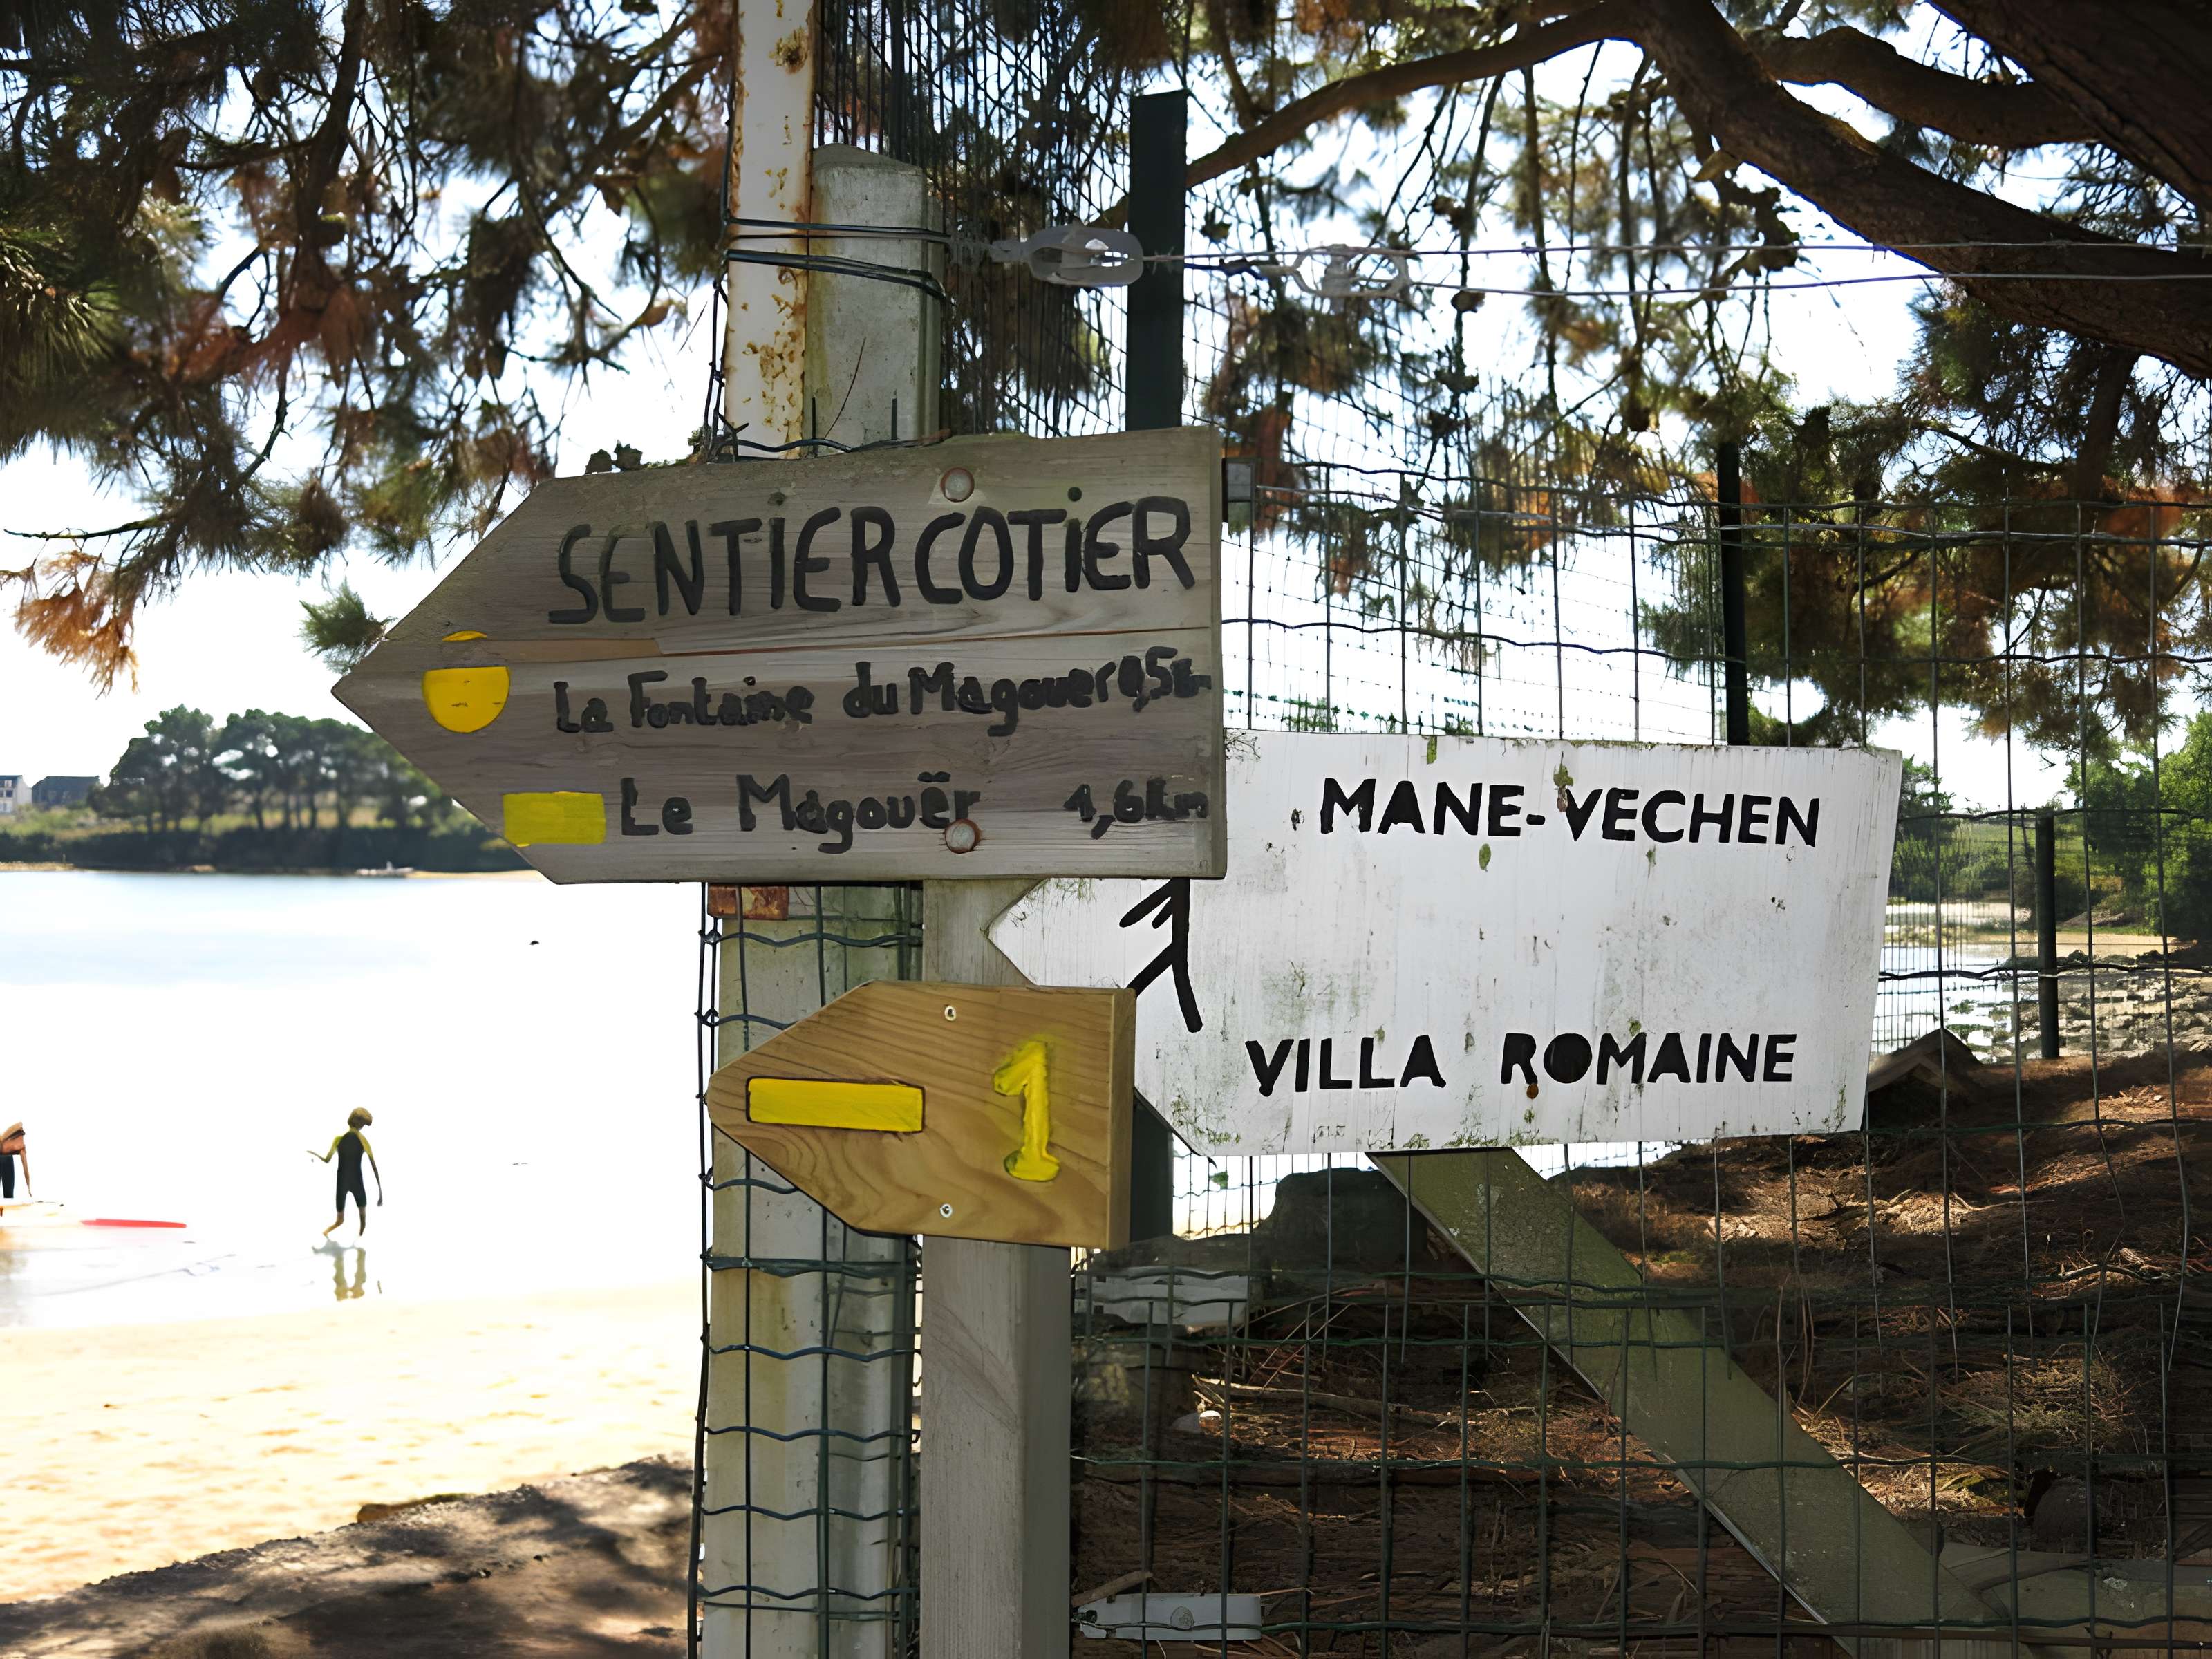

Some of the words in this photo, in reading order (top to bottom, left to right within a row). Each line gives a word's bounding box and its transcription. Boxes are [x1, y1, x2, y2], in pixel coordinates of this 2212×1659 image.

[549, 507, 900, 624] SENTIER
[554, 681, 614, 733] La
[628, 670, 815, 729] Fontaine
[843, 662, 898, 718] du
[621, 778, 693, 836] Le
[736, 774, 981, 854] Magouër
[1320, 778, 1819, 847] MANE-VECHEN
[1245, 1035, 1447, 1096] VILLA
[1501, 1033, 1797, 1084] ROMAINE
[993, 1041, 1060, 1183] 1
